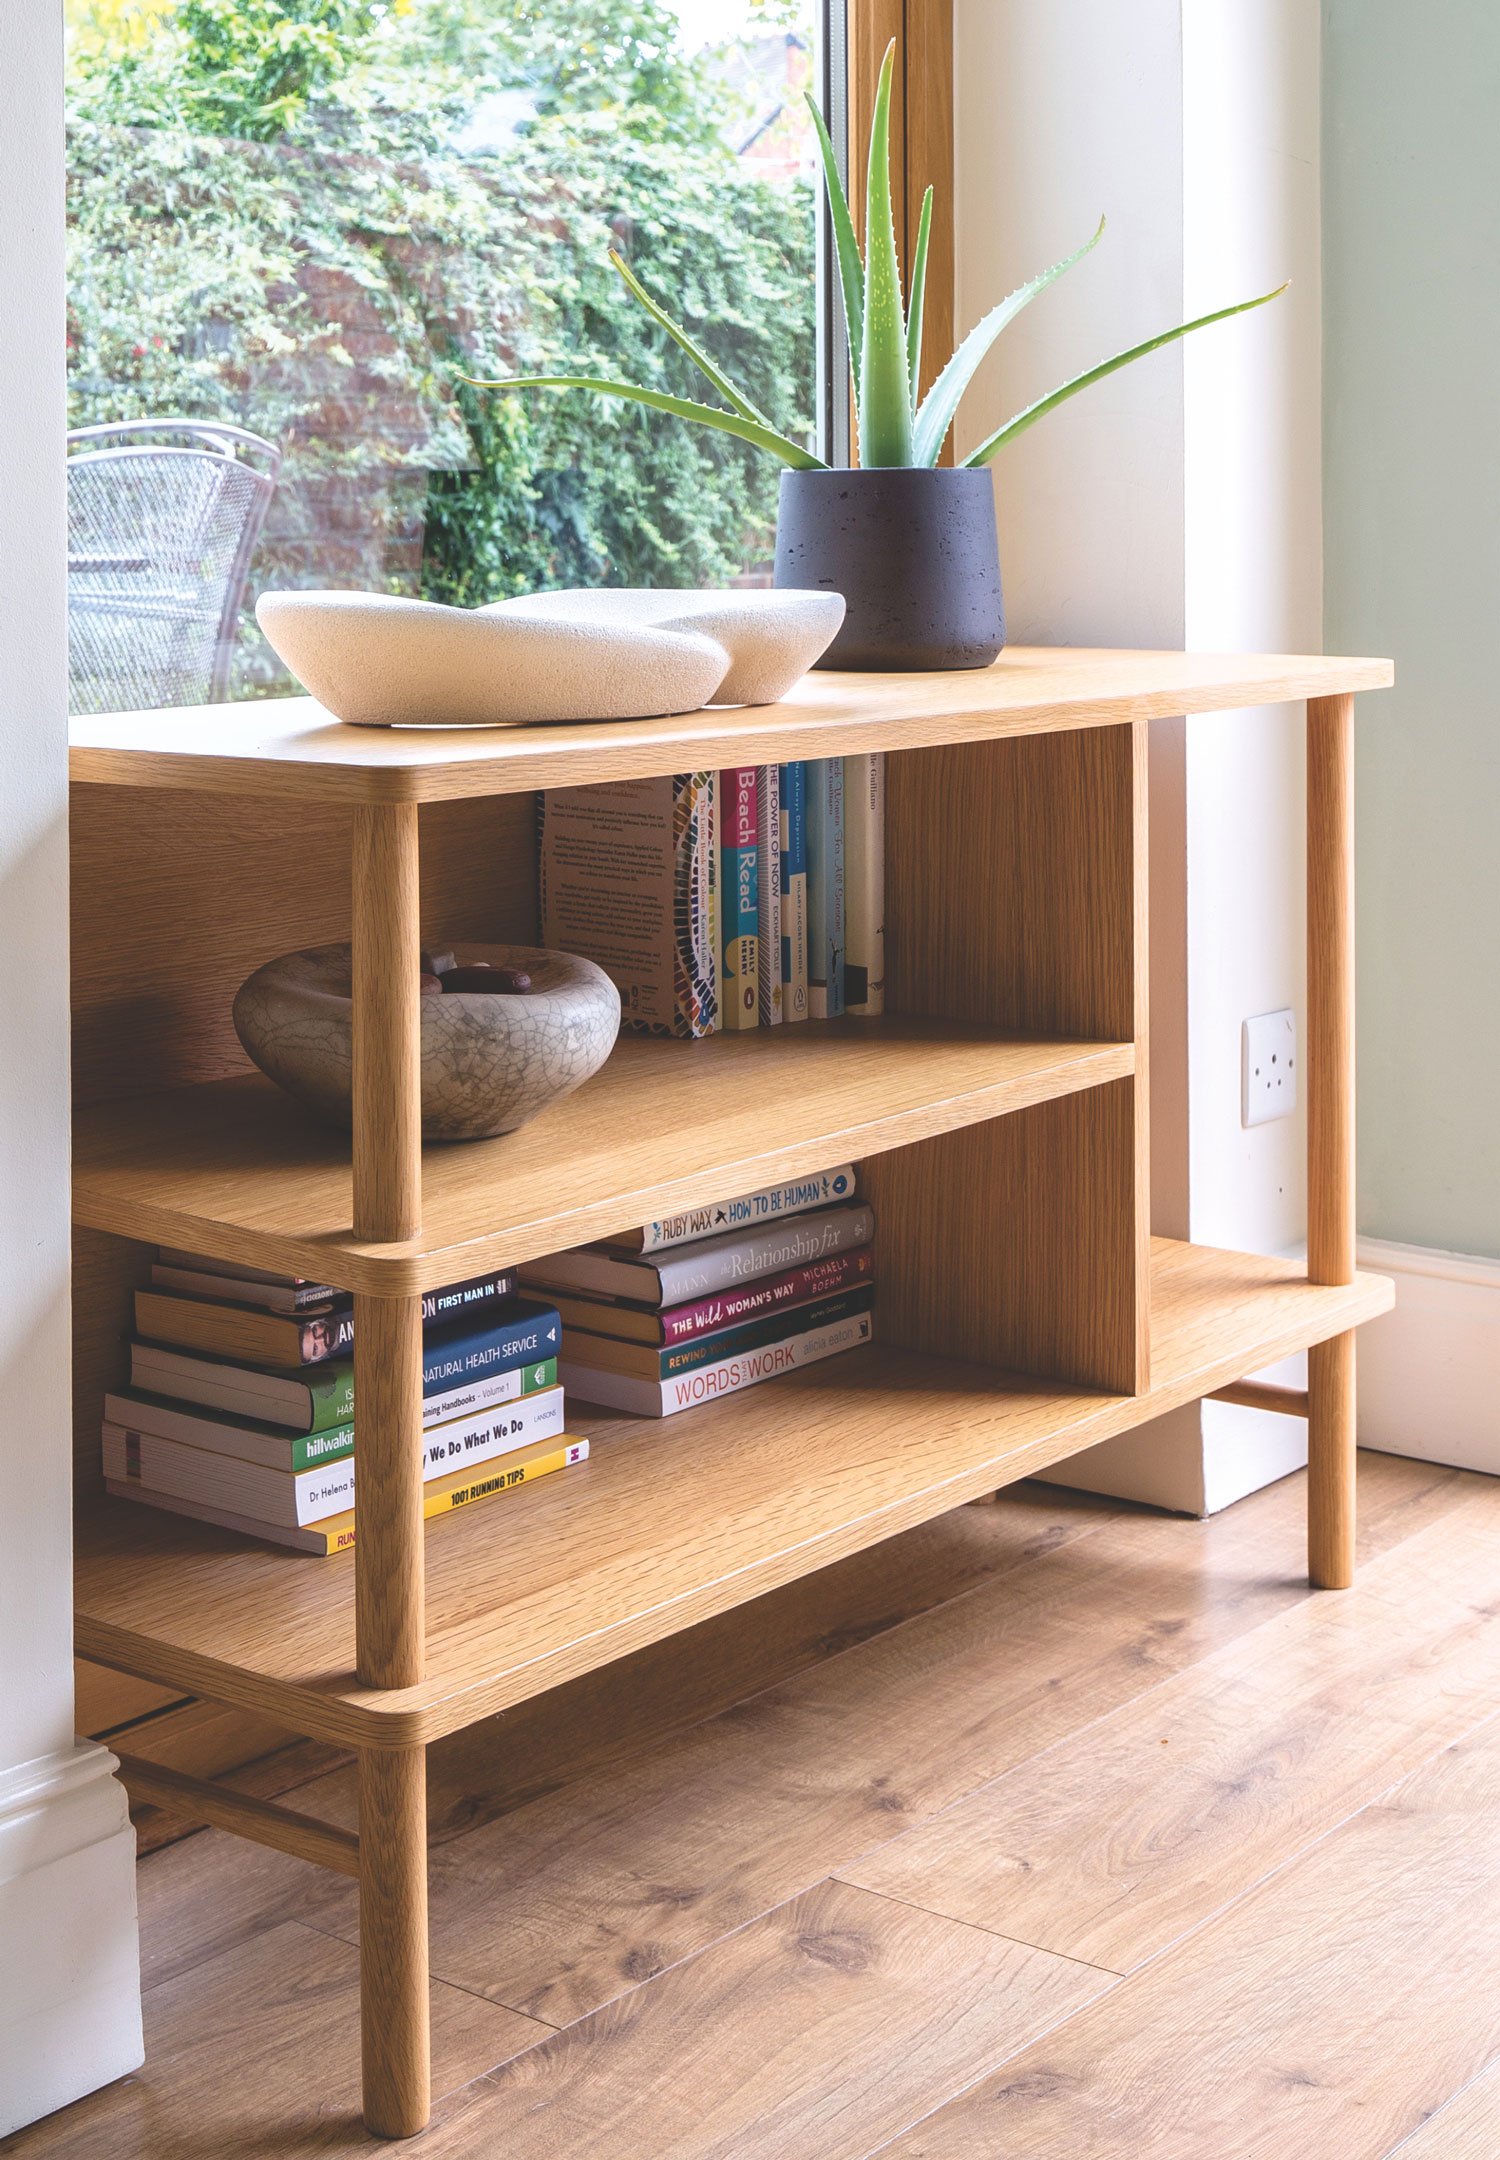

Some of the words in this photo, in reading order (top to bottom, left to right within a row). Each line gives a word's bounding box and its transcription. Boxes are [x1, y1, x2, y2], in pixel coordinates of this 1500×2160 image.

[770, 764, 778, 785] THE
[869, 769, 877, 810] Guiliano
[739, 770, 756, 844] Beach
[770, 790, 779, 837] POWER
[835, 781, 843, 826] Women
[771, 841, 779, 859] OF
[835, 829, 843, 854] For
[700, 867, 706, 875] of
[740, 851, 757, 914] Read
[772, 864, 780, 897] NOW
[835, 858, 843, 884] All
[835, 887, 843, 932] Seasons
[729, 1199, 751, 1223] HOW
[753, 1196, 768, 1215] TO
[771, 1191, 782, 1211] BE
[784, 1181, 820, 1208] HUMAN
[663, 1215, 688, 1241] RUBY
[690, 1209, 712, 1234] WAX
[720, 1263, 732, 1275] the
[731, 1231, 820, 1278] Relationship
[816, 1225, 841, 1258] fix
[671, 1273, 709, 1297] MANN
[802, 1259, 849, 1282] MICHAELA
[812, 1275, 842, 1294] BOEHM
[339, 1320, 354, 1344] AN
[438, 1293, 463, 1310] FIRST
[464, 1287, 483, 1302] MAN
[485, 1284, 494, 1296] IN
[672, 1318, 693, 1335] THE
[695, 1302, 723, 1328] Wild
[726, 1291, 772, 1316] WOMAN'S
[773, 1282, 794, 1299] WAY
[803, 1337, 826, 1355] alicia
[829, 1329, 854, 1346] eaton
[423, 1359, 464, 1384] NATURAL
[465, 1347, 500, 1370] HEALTH
[502, 1334, 538, 1358] SERVICE
[669, 1348, 707, 1369] REWIND
[675, 1363, 741, 1405] WORDS
[741, 1360, 749, 1382] THAT
[747, 1344, 795, 1379] WORK
[337, 1401, 354, 1417] HAR
[345, 1388, 353, 1401] IS
[423, 1406, 441, 1417] aining
[441, 1394, 476, 1411] Handbooks
[482, 1385, 505, 1398] Volume
[505, 1382, 510, 1391] 1
[533, 1409, 557, 1423] LANSONS
[430, 1446, 445, 1462] We
[448, 1441, 461, 1456] Do
[464, 1430, 490, 1450] What
[493, 1424, 508, 1440] We
[511, 1420, 523, 1434] Do
[309, 1491, 319, 1503] Dr
[321, 1483, 348, 1499] Helena
[452, 1488, 469, 1506] 1001
[470, 1475, 505, 1499] RUNNING
[507, 1468, 525, 1485] TIPS
[337, 1531, 355, 1548] RUN
